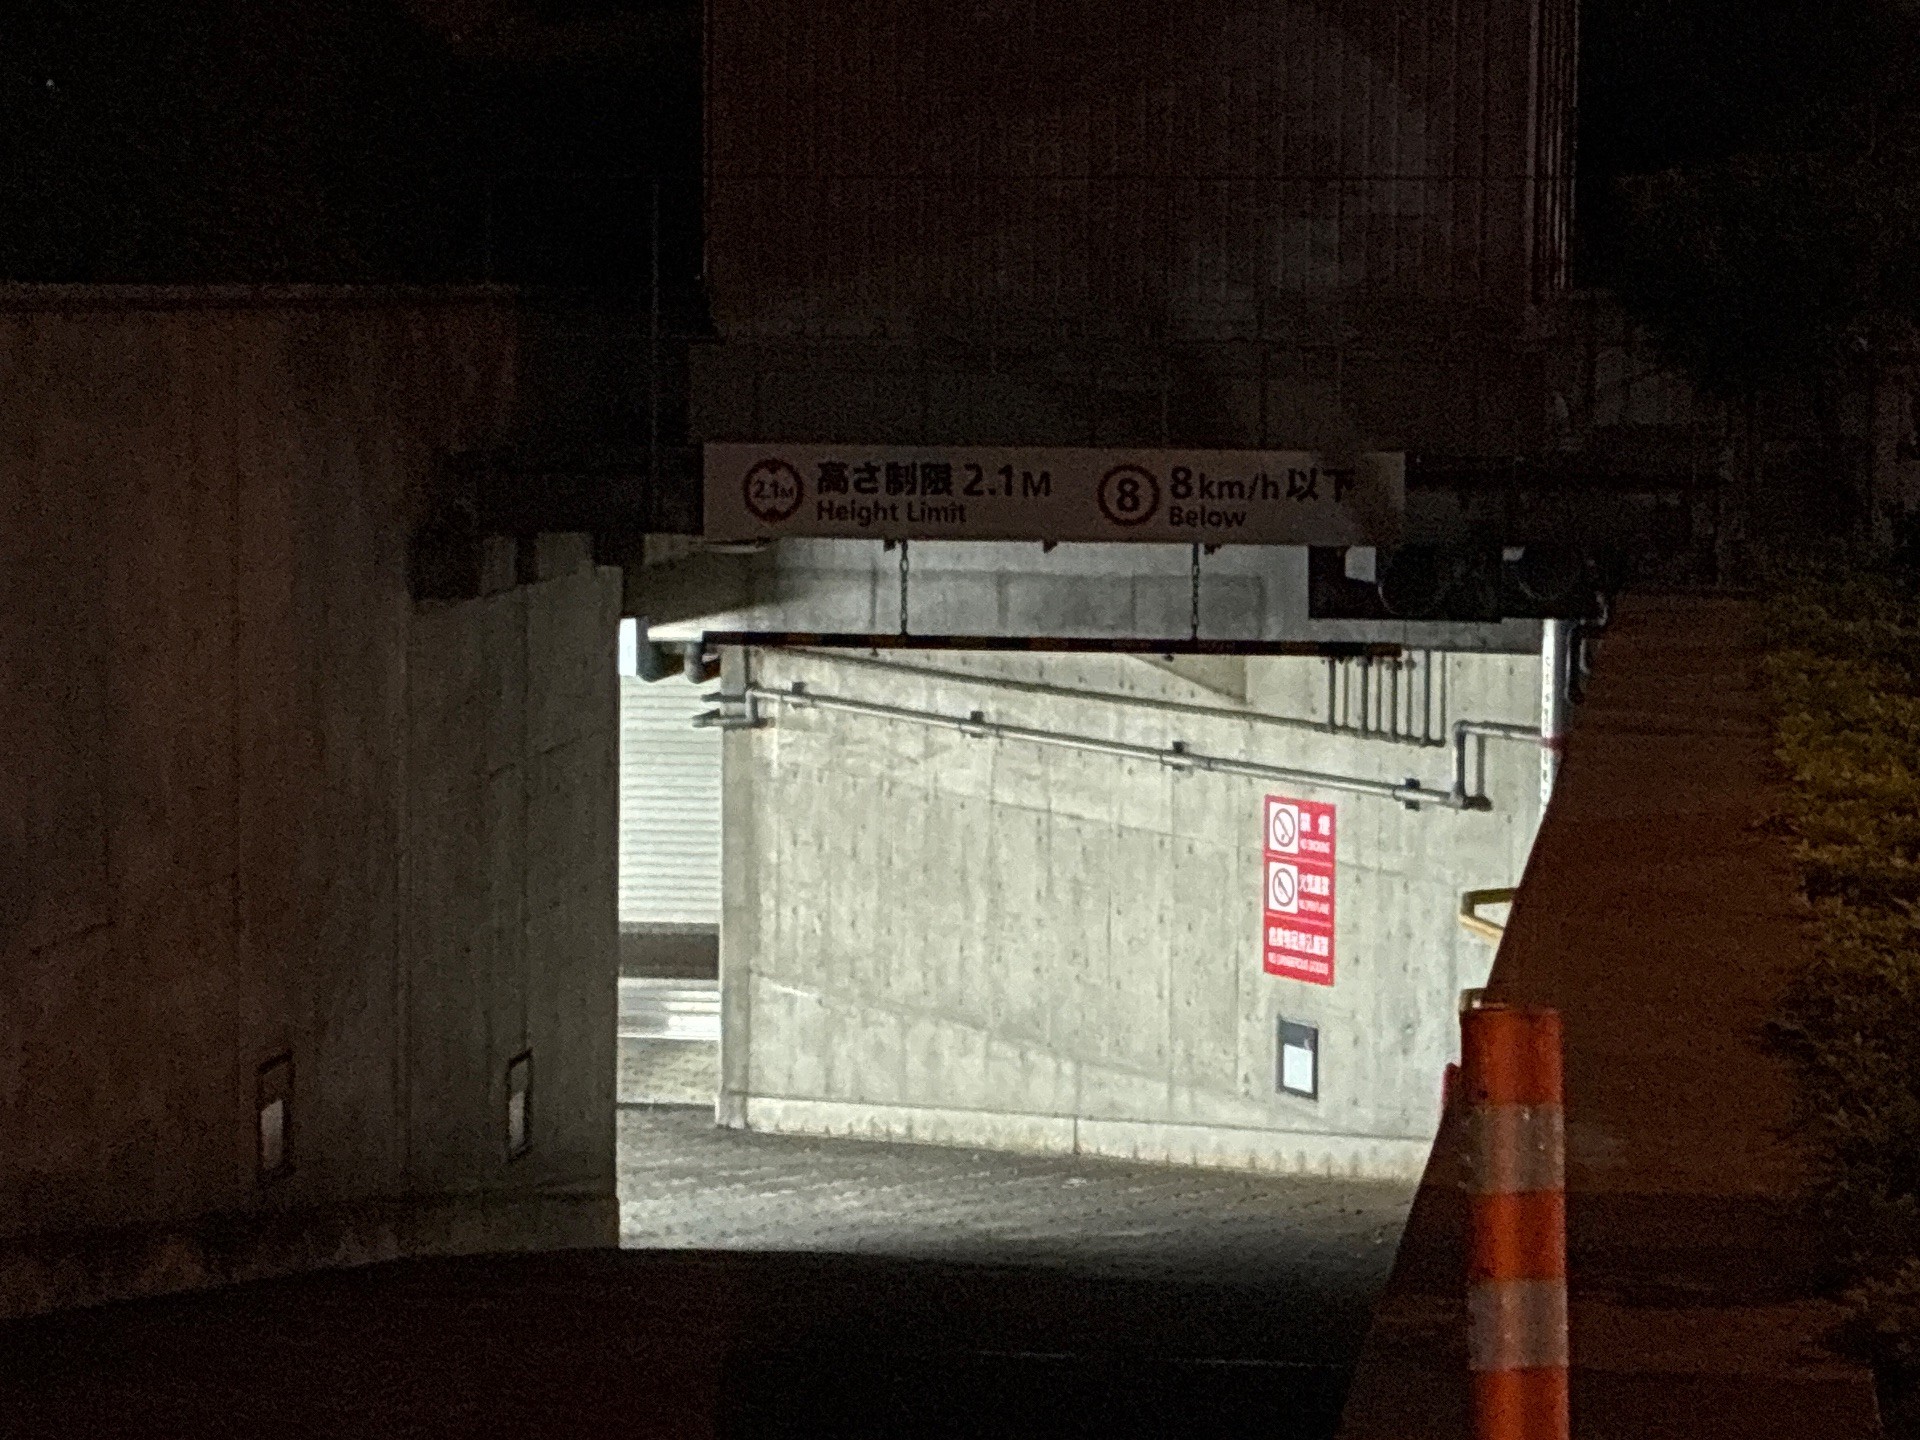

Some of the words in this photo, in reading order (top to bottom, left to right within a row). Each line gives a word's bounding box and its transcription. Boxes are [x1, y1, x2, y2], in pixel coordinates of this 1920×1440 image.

[816, 462, 953, 496] 高さ制限
[1117, 478, 1140, 512] 8
[817, 500, 899, 526] Height
[907, 500, 967, 523] Limit
[1169, 506, 1247, 527] Below
